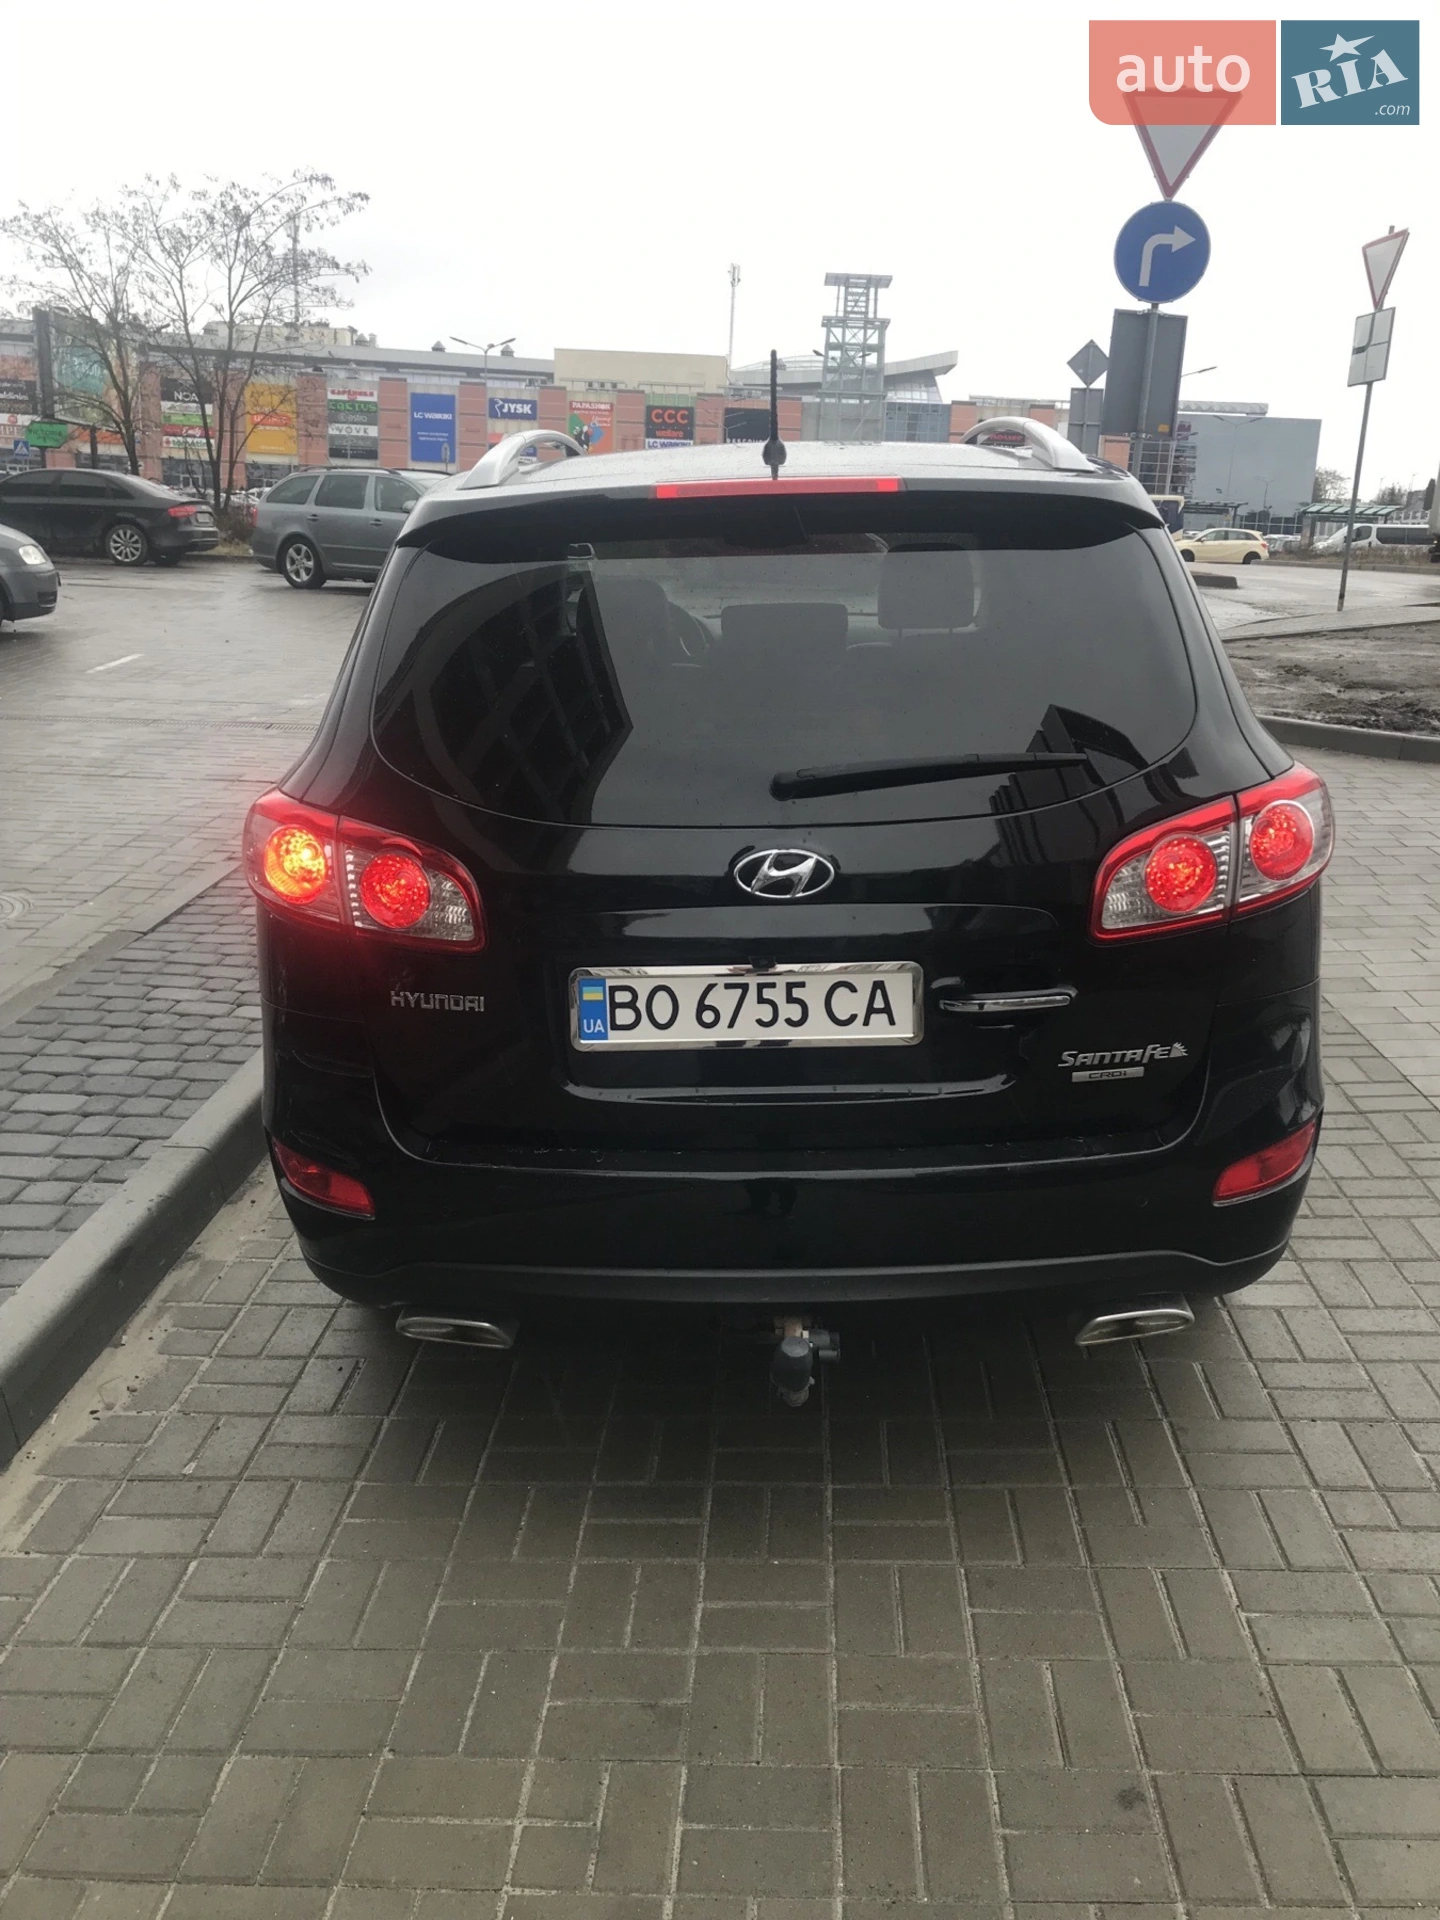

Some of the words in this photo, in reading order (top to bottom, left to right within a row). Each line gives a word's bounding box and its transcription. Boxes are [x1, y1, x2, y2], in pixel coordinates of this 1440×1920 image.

[502, 403, 532, 415] JYSK
[651, 409, 689, 424] CCC
[390, 990, 485, 1012] HYUNDAI
[608, 984, 680, 1031] BO
[695, 981, 810, 1030] 6755
[824, 980, 896, 1028] CA
[582, 1018, 605, 1034] UA
